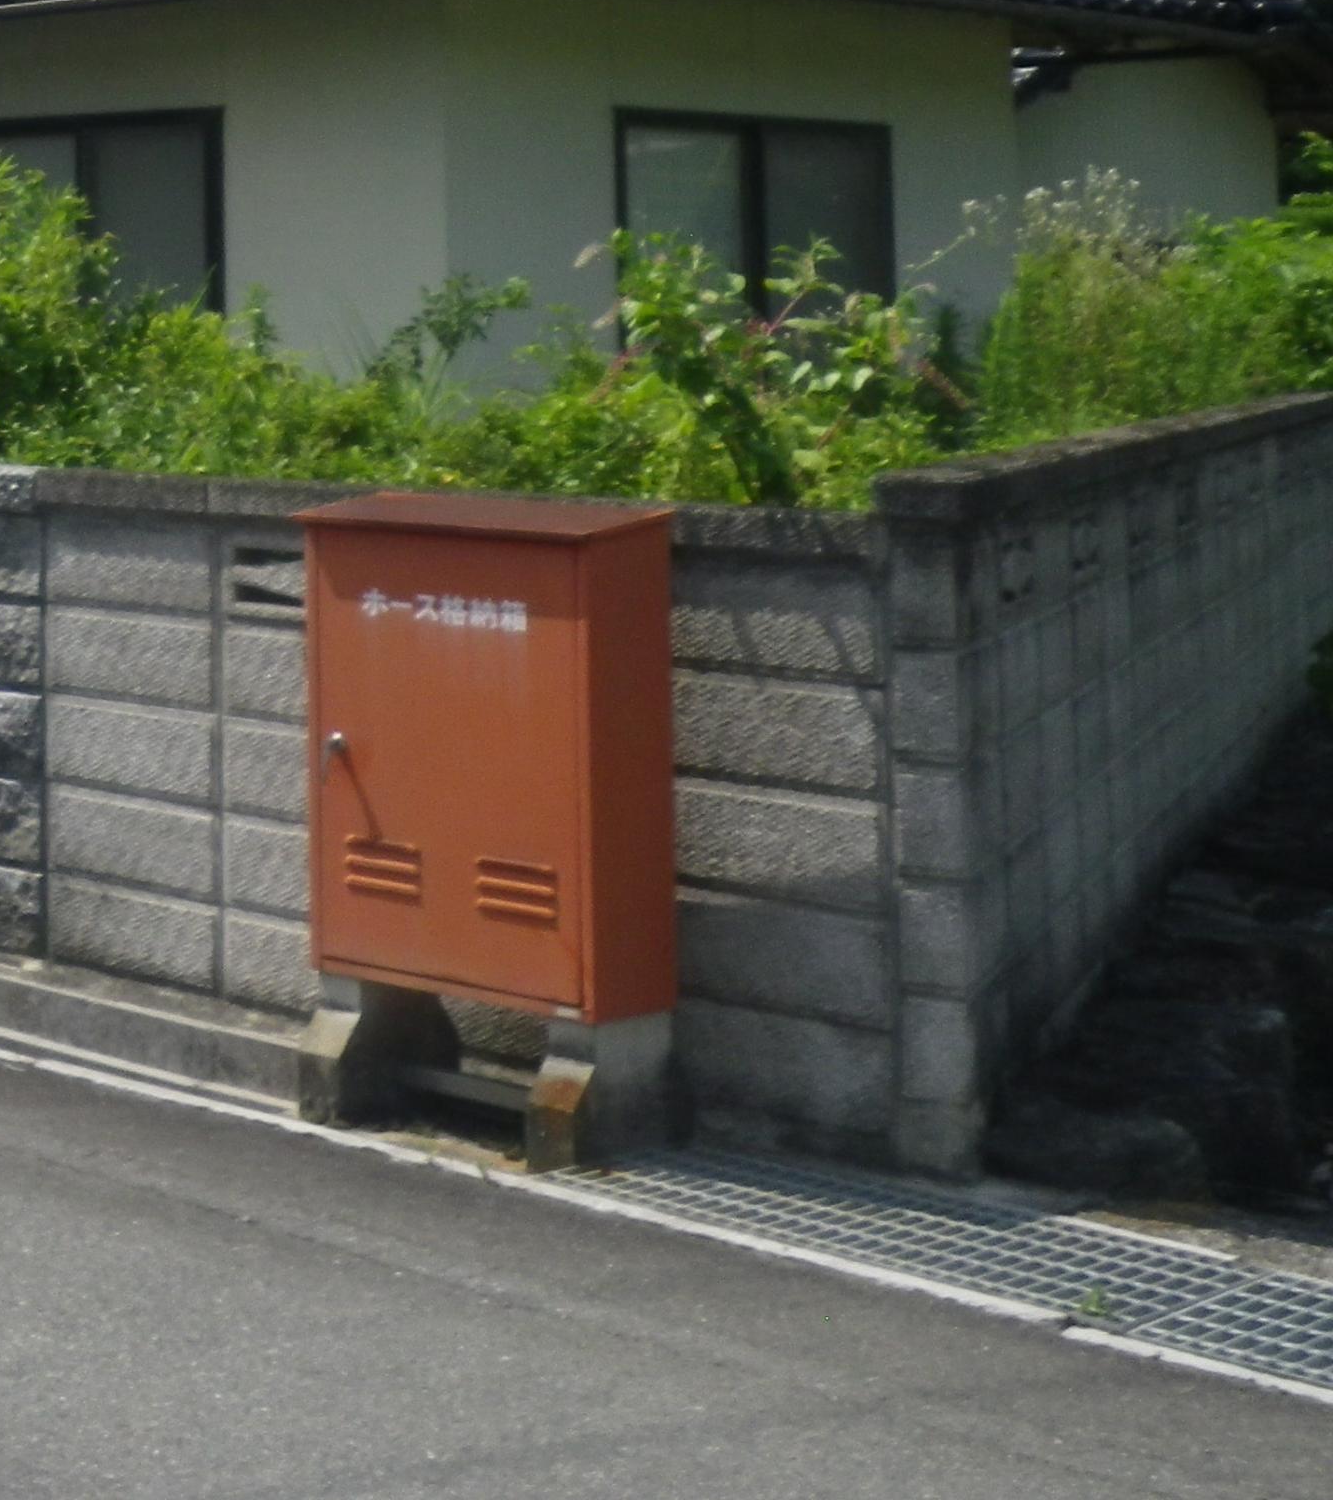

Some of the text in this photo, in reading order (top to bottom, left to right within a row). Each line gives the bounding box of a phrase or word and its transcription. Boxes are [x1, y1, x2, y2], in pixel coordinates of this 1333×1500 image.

[360, 587, 528, 633] ホース格納箱
